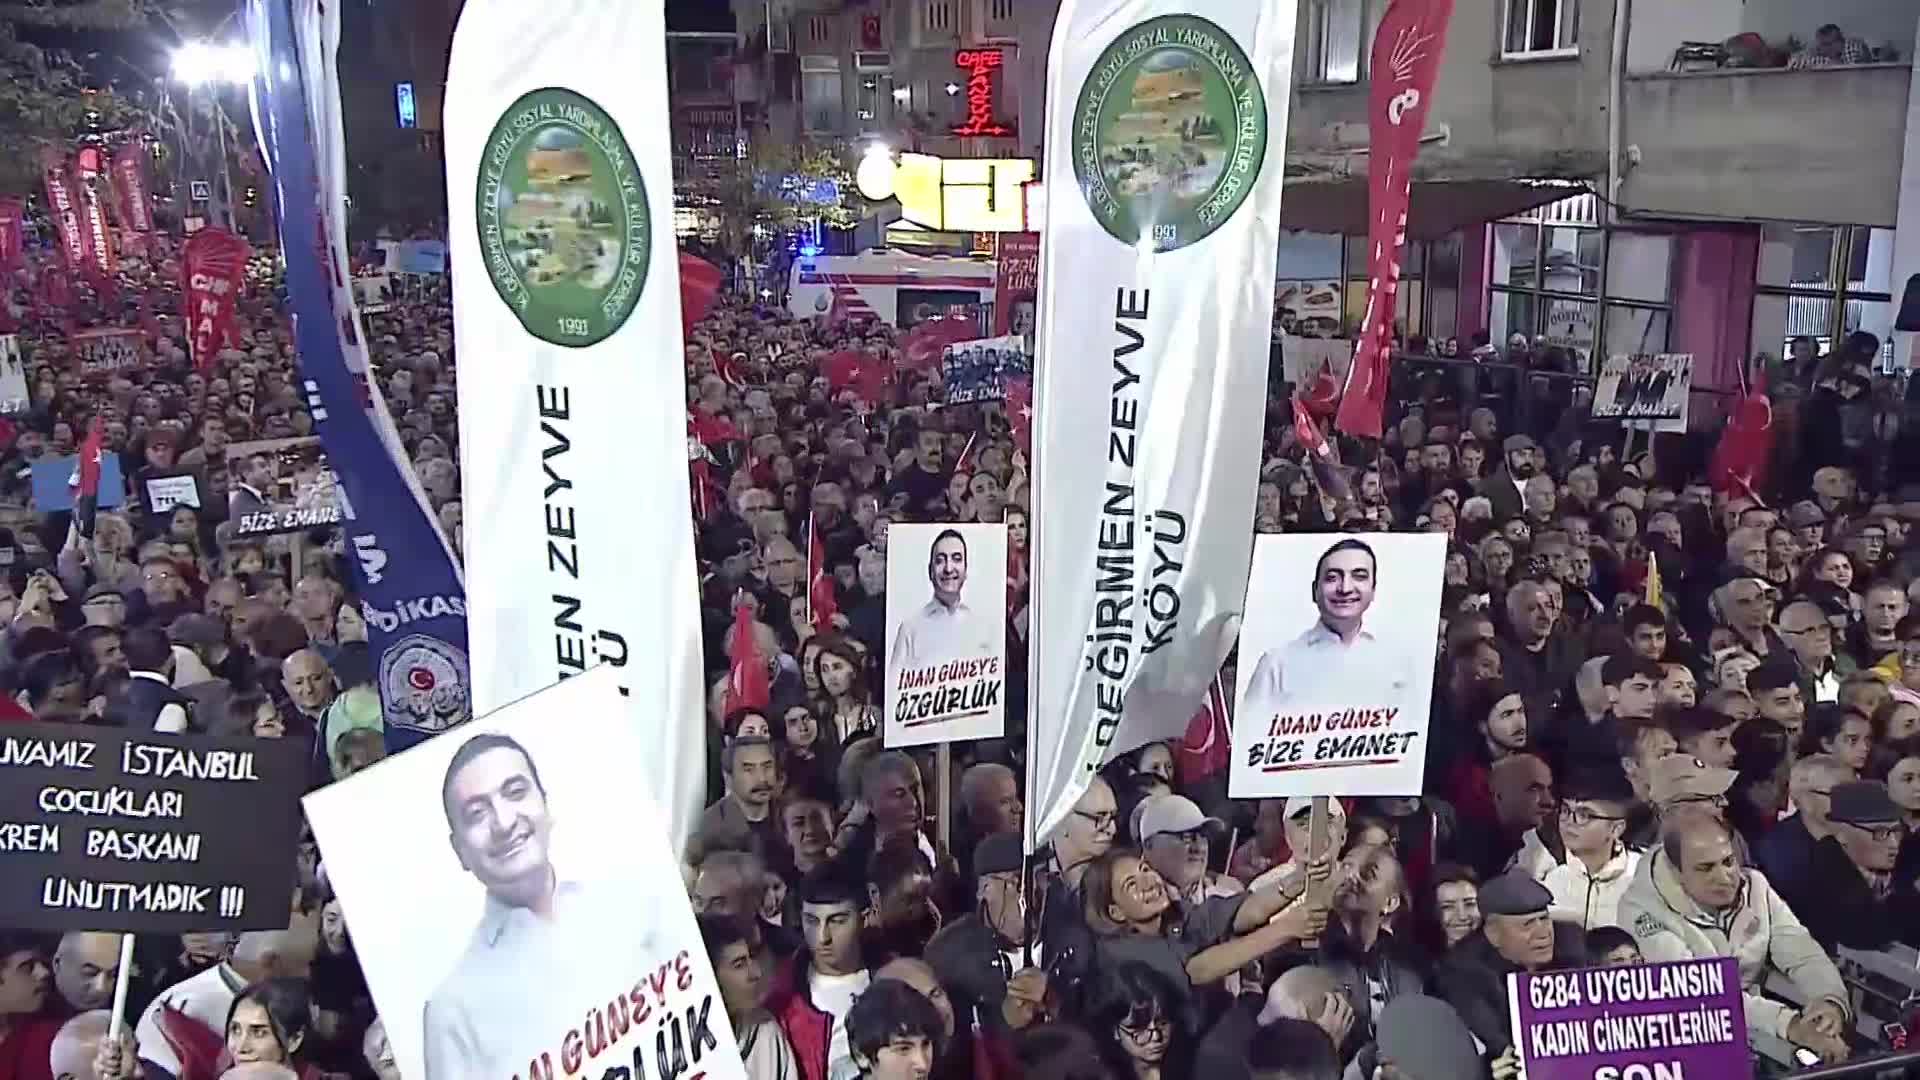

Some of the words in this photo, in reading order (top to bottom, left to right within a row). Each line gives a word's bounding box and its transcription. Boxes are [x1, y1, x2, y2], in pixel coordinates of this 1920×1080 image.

[956, 51, 1003, 66] CAFE
[1126, 28, 1169, 58] SOSYAL
[1238, 115, 1258, 173] KÜLTÜR
[1109, 287, 1150, 467] ZEYVE
[537, 385, 578, 579] ZEYVE
[239, 511, 278, 533] BİZE
[1141, 510, 1186, 654] KÖYÜ
[1086, 481, 1135, 748] DEĞİRMEN
[895, 678, 1001, 722] ÖZGÜRLÜK
[897, 667, 935, 690] İNAN
[1268, 714, 1322, 737] İNAN
[1326, 707, 1399, 730] GÜNEY
[122, 742, 259, 781] İSTANBUL
[1248, 738, 1304, 767] BİZE
[1315, 732, 1418, 760] EMANET
[86, 829, 201, 861] BAŞKANI
[43, 876, 212, 913] UNUTMADIK
[219, 886, 245, 918] !!!
[1529, 973, 1581, 1009] 6284
[1586, 962, 1725, 1005] UYGULANSIN
[562, 950, 693, 1076] GÜNEY'E
[1530, 1020, 1590, 1059] KADIN
[1593, 1003, 1734, 1051] CİNAYETLERİNE
